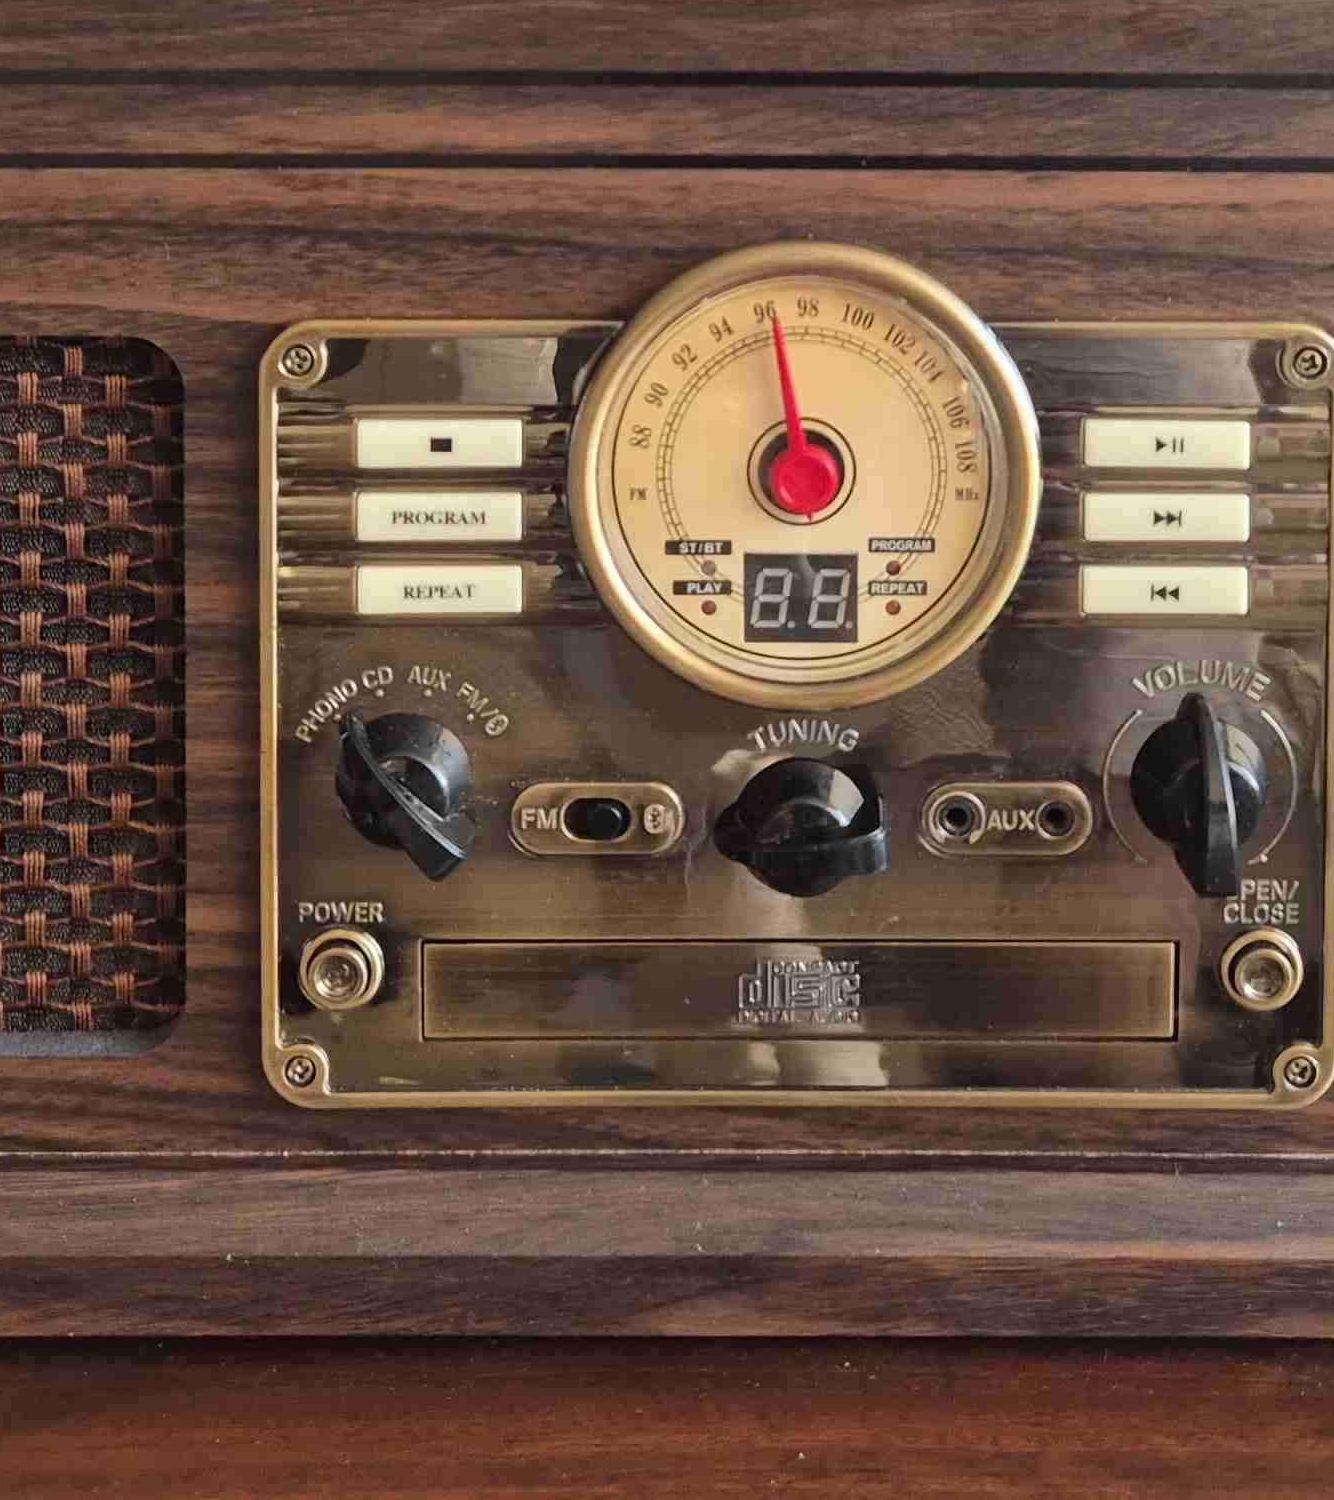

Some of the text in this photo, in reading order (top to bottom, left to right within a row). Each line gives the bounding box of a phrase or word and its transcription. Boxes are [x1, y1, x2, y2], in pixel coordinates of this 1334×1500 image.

[644, 382, 670, 408] 90
[671, 343, 699, 372] 92
[707, 316, 734, 341] 94
[796, 297, 820, 318] 98
[841, 302, 875, 332] 100
[883, 323, 916, 354] 102
[391, 510, 487, 525] PROGRAM
[870, 538, 933, 553] PROGRAM
[403, 583, 476, 600] REPEAT
[686, 582, 723, 595] PLAY
[870, 581, 925, 596] REPEAT
[1131, 659, 1271, 702] VOLUME
[294, 678, 359, 744] PHONO
[361, 665, 394, 691] CD
[406, 664, 452, 692] AUX
[747, 718, 860, 752] TUNING
[520, 808, 559, 830] FM
[987, 810, 1036, 831] AUX
[1227, 879, 1300, 901] PEN/
[298, 901, 385, 924] POWER
[1223, 902, 1300, 925] CLOSE
